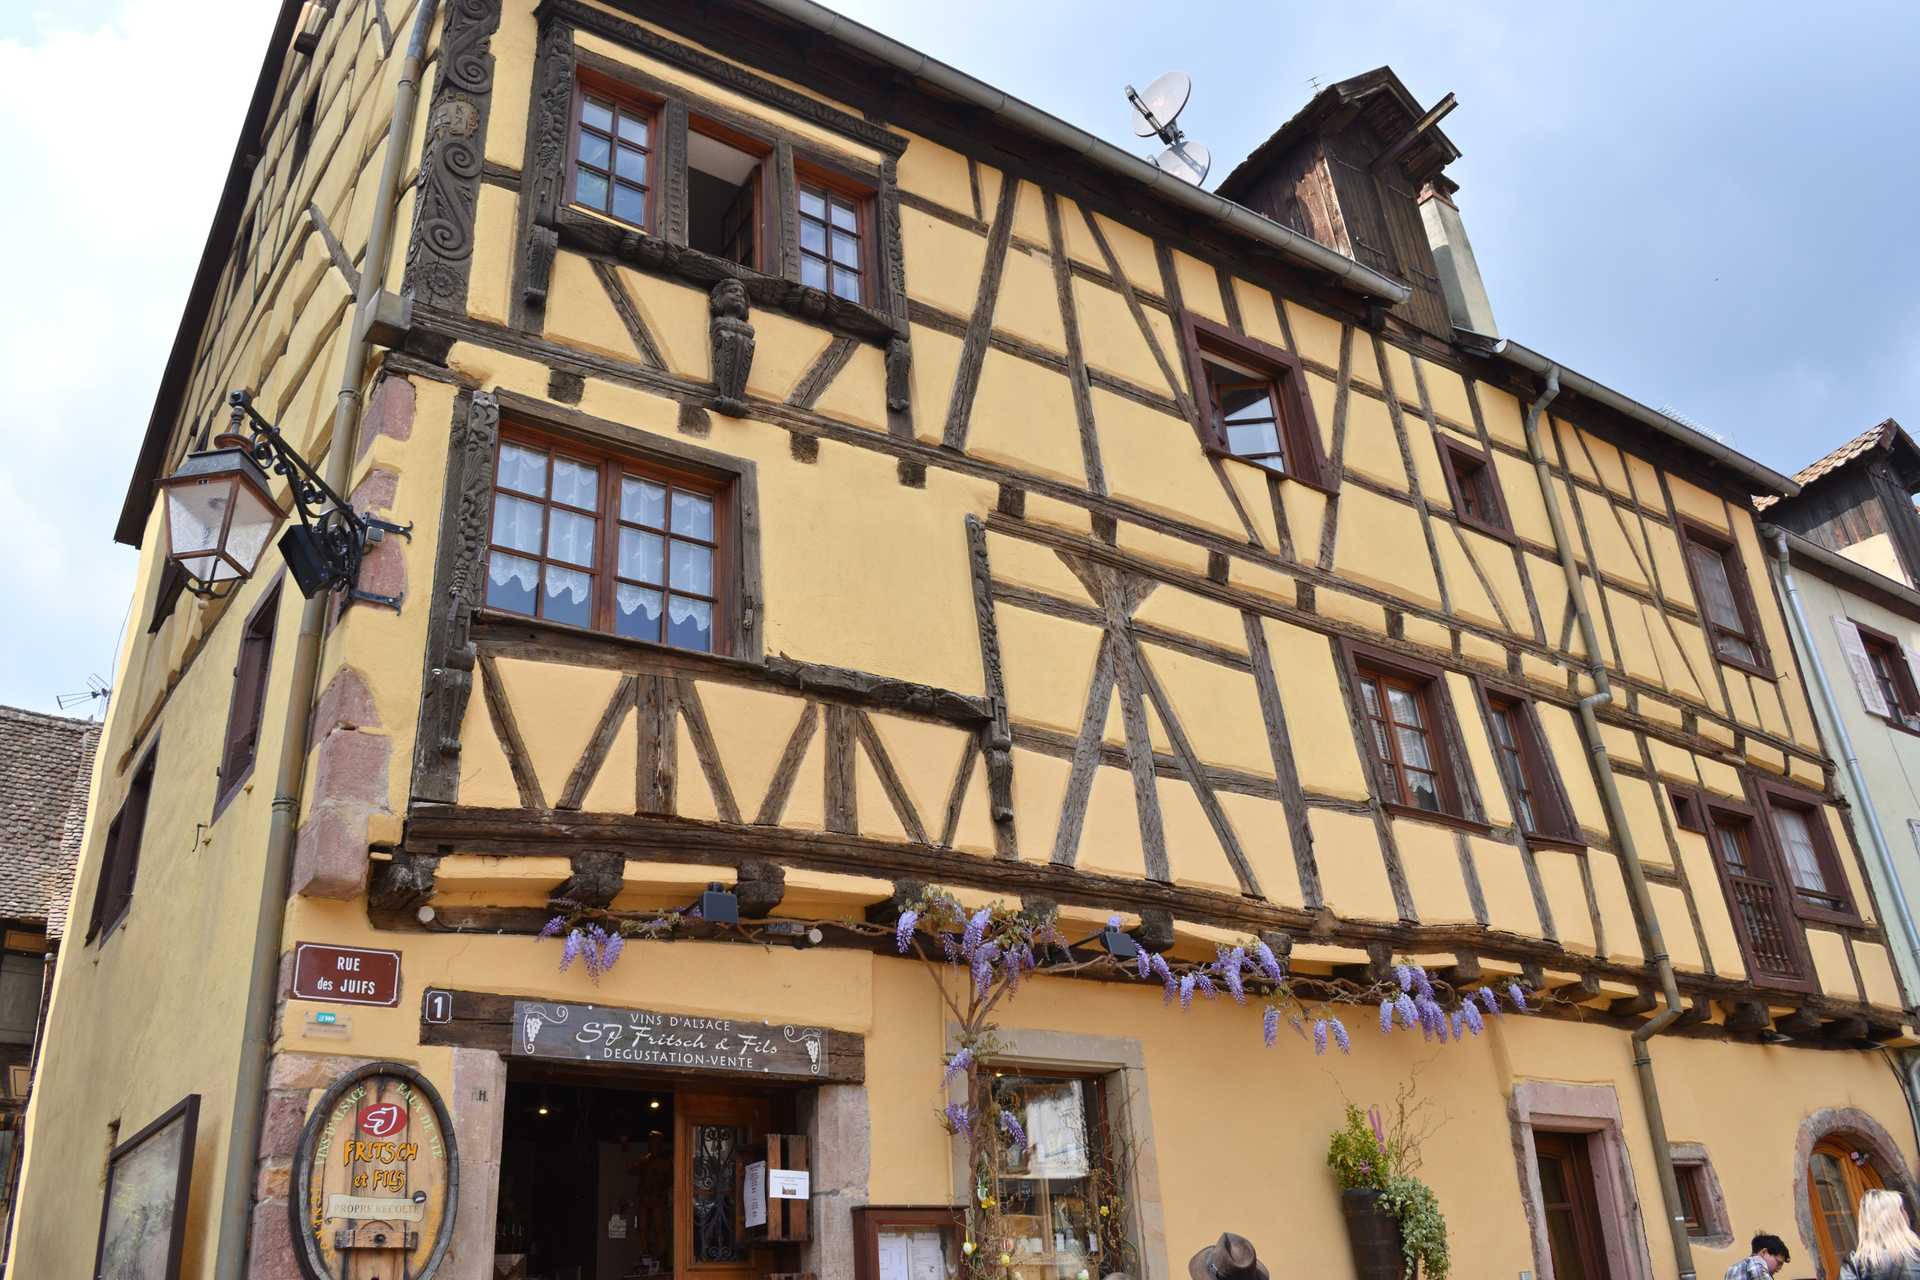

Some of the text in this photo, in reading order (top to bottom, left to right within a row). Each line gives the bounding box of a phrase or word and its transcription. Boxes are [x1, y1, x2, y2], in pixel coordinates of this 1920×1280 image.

[337, 956, 361, 971] RUE
[317, 977, 375, 995] des JUIFS
[434, 996, 443, 1018] 1
[630, 1013, 730, 1032] VINS D'ALSACE
[629, 1024, 707, 1049] Fritsch
[737, 1033, 778, 1055] Fils
[603, 1047, 753, 1068] DEGUSTATION-VENTE
[396, 1083, 424, 1113] EAUX
[343, 1140, 418, 1167] FRITSCH
[353, 1169, 405, 1192] et FILS
